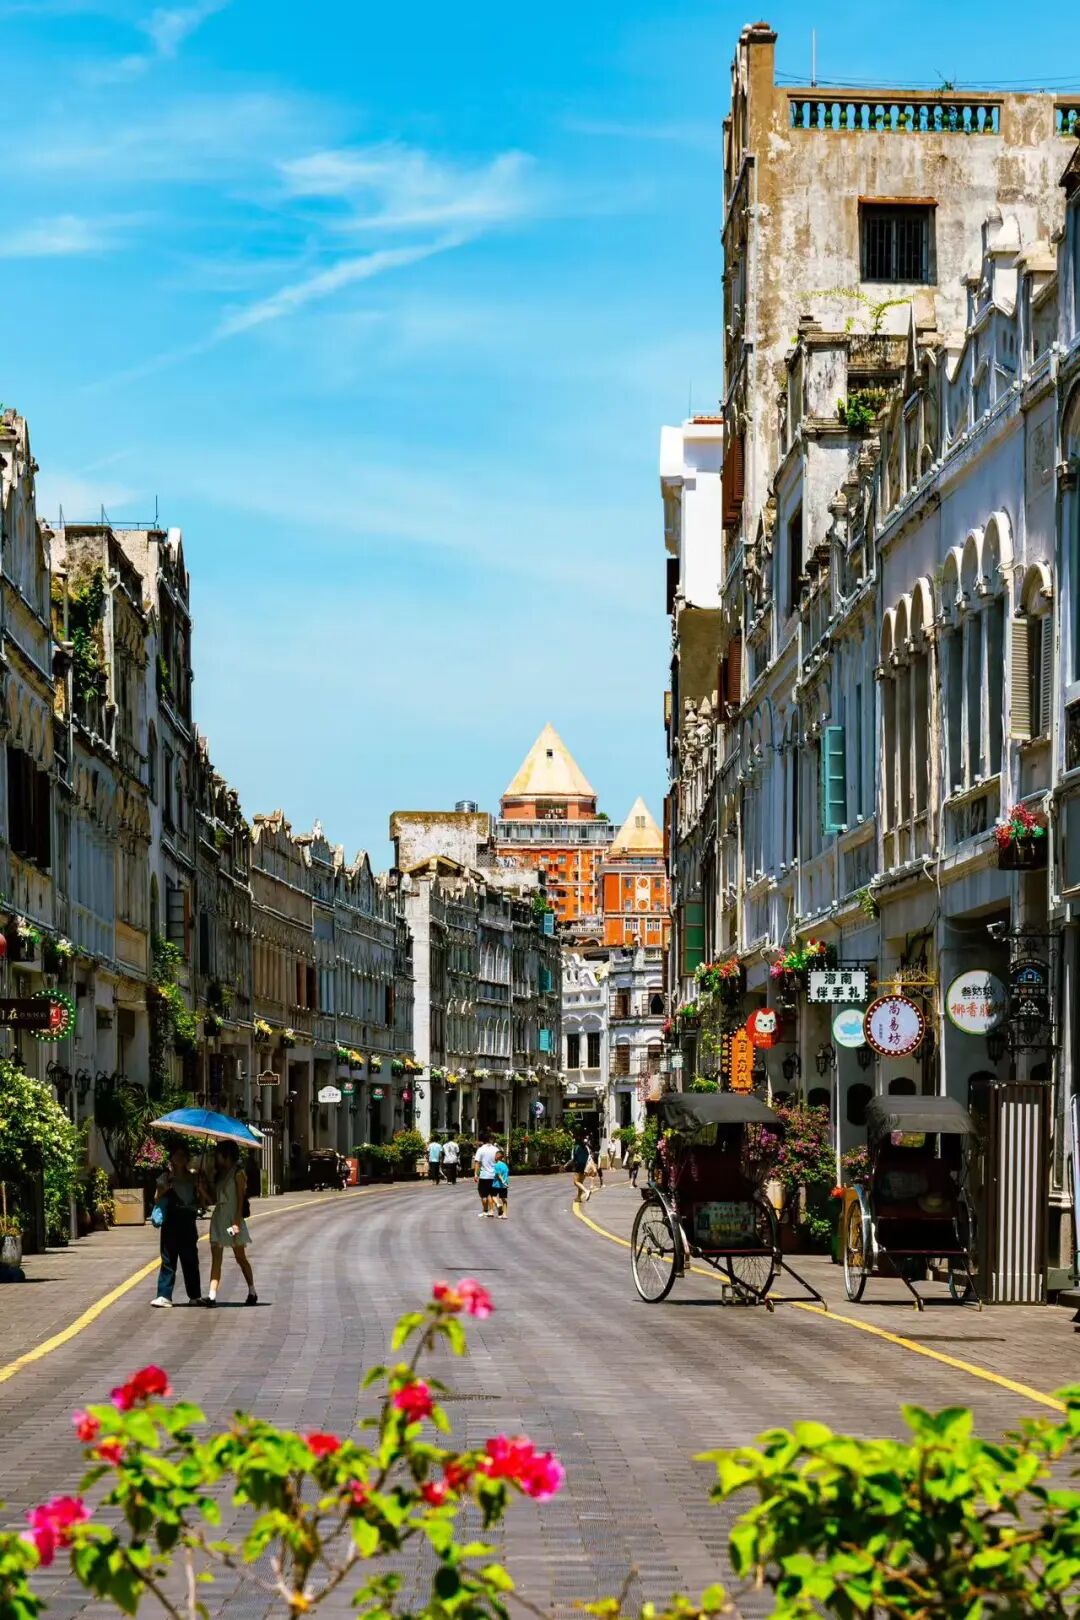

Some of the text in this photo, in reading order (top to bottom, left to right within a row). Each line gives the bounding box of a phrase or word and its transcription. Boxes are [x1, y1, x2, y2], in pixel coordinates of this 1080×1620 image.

[824, 973, 853, 985] 海南
[816, 986, 861, 999] 伴手礼
[888, 1001, 902, 1045] 尚易坊
